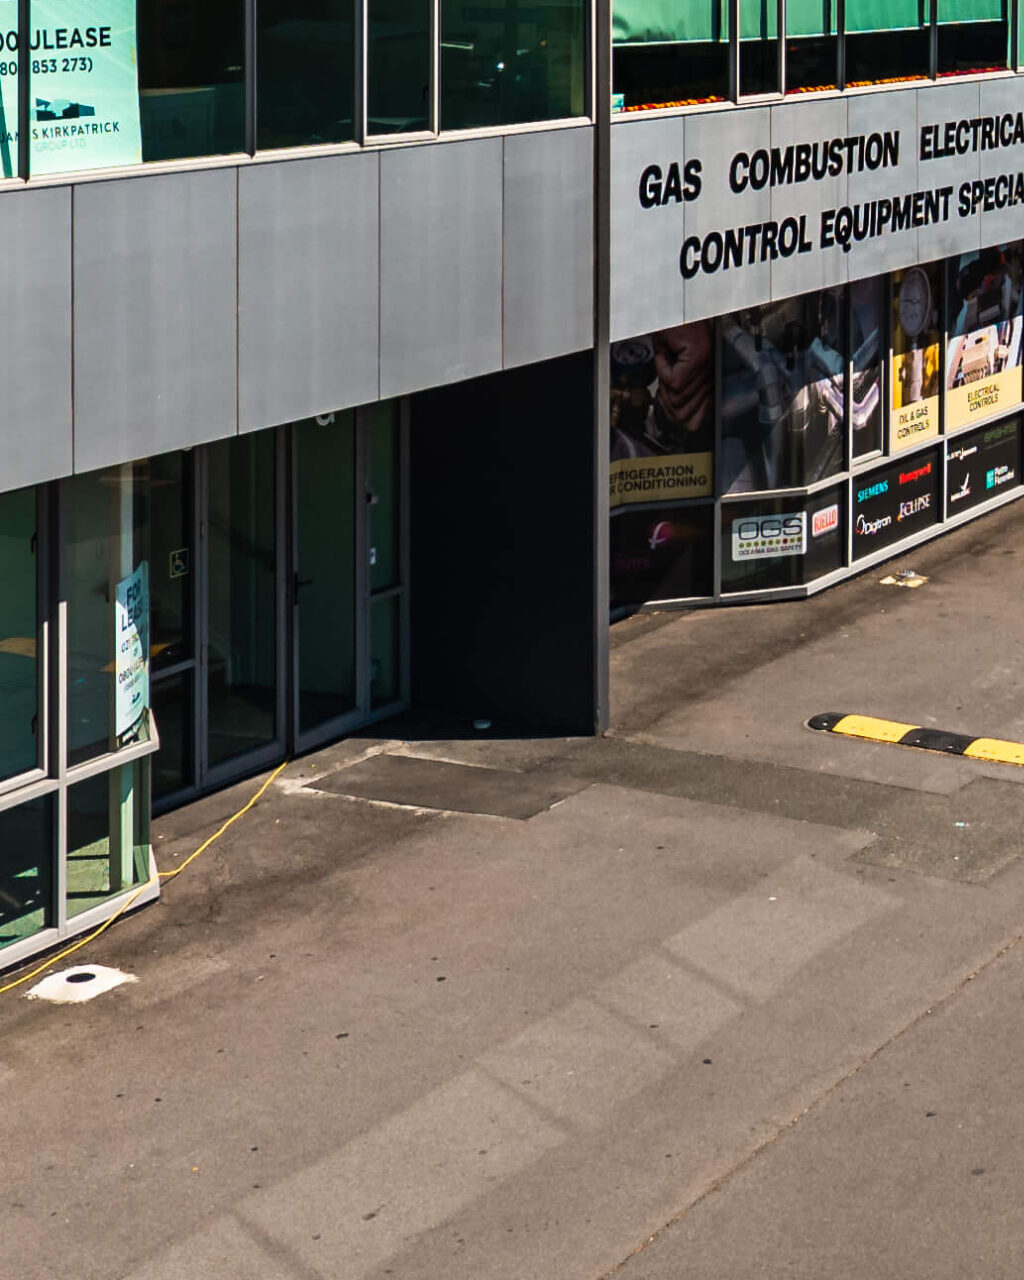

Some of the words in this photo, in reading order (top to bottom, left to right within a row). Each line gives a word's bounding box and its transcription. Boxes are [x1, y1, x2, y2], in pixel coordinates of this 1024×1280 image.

[32, 59, 58, 74] 853
[61, 57, 93, 73] 273)
[42, 121, 120, 139] KIRKPATRICK
[638, 158, 702, 210] GAS
[729, 130, 900, 195] COMBUSTION
[679, 218, 812, 280] CONTROL
[820, 185, 954, 254] EQUIPMENT
[967, 383, 1000, 403] ELECTRICAL
[969, 393, 999, 412] CONTROLS
[897, 419, 930, 439] CONTROLS
[610, 464, 694, 484] EFRIGERATION
[618, 474, 707, 493] CONDITIONING
[857, 480, 889, 503] SIEMENS
[900, 493, 931, 519] ECLIPSE
[738, 517, 803, 541] OGS
